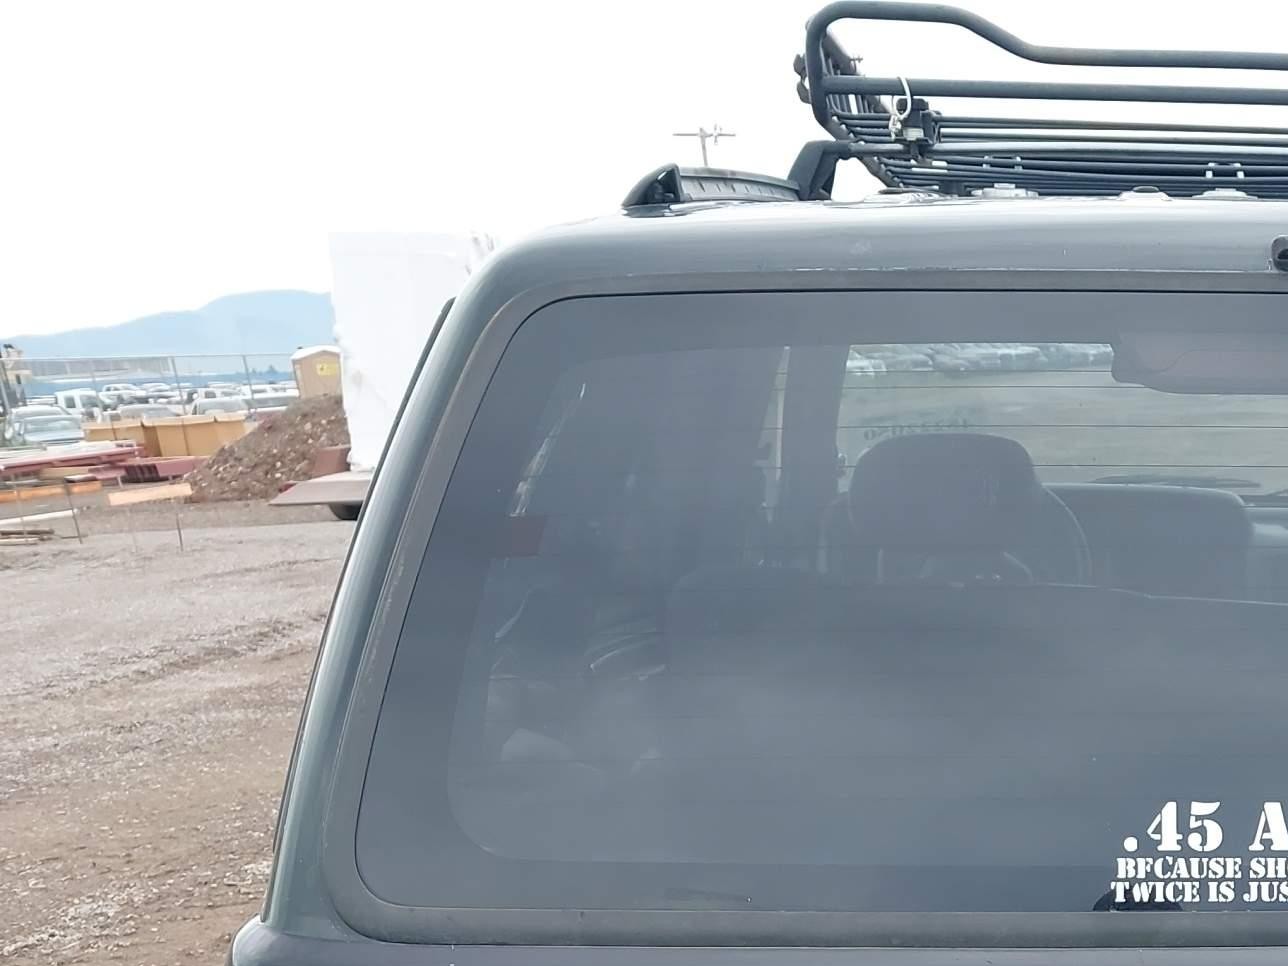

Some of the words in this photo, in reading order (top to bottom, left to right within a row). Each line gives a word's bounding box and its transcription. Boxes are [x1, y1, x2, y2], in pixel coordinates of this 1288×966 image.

[1123, 801, 1223, 852] .45
[1116, 856, 1242, 879] BECAUSE
[1110, 880, 1200, 903] TWICE
[1207, 880, 1235, 903] IS
